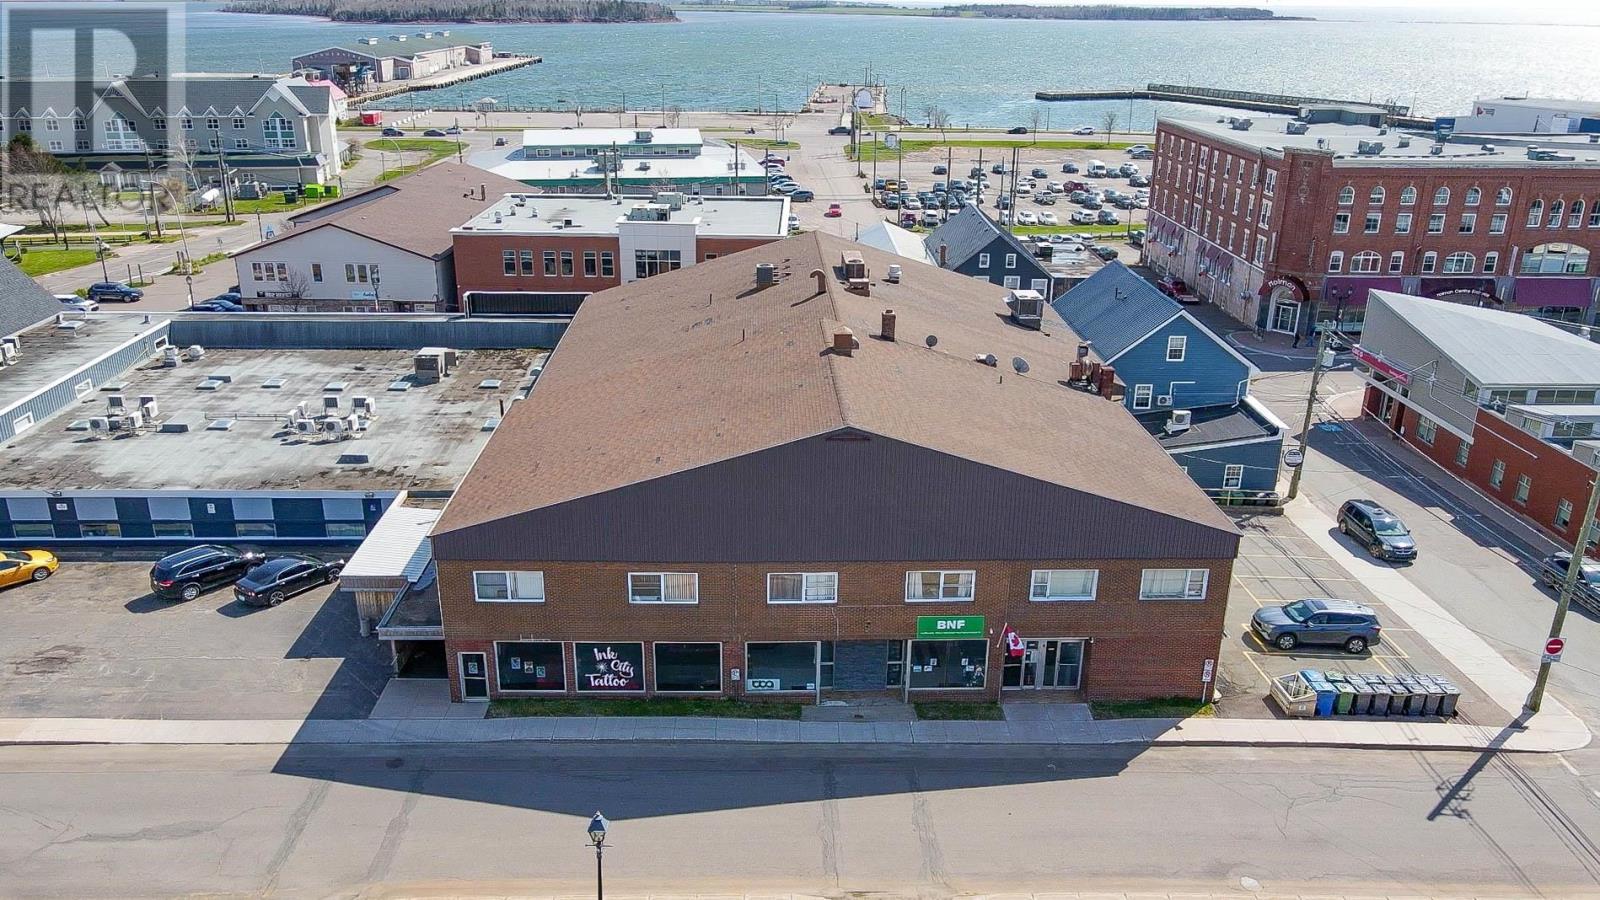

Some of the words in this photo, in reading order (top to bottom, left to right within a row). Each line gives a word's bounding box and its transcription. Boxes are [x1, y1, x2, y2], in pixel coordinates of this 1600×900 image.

[936, 619, 966, 630] BNF
[593, 646, 618, 661] Ink
[610, 659, 634, 678] City
[584, 673, 630, 687] Tattoo
